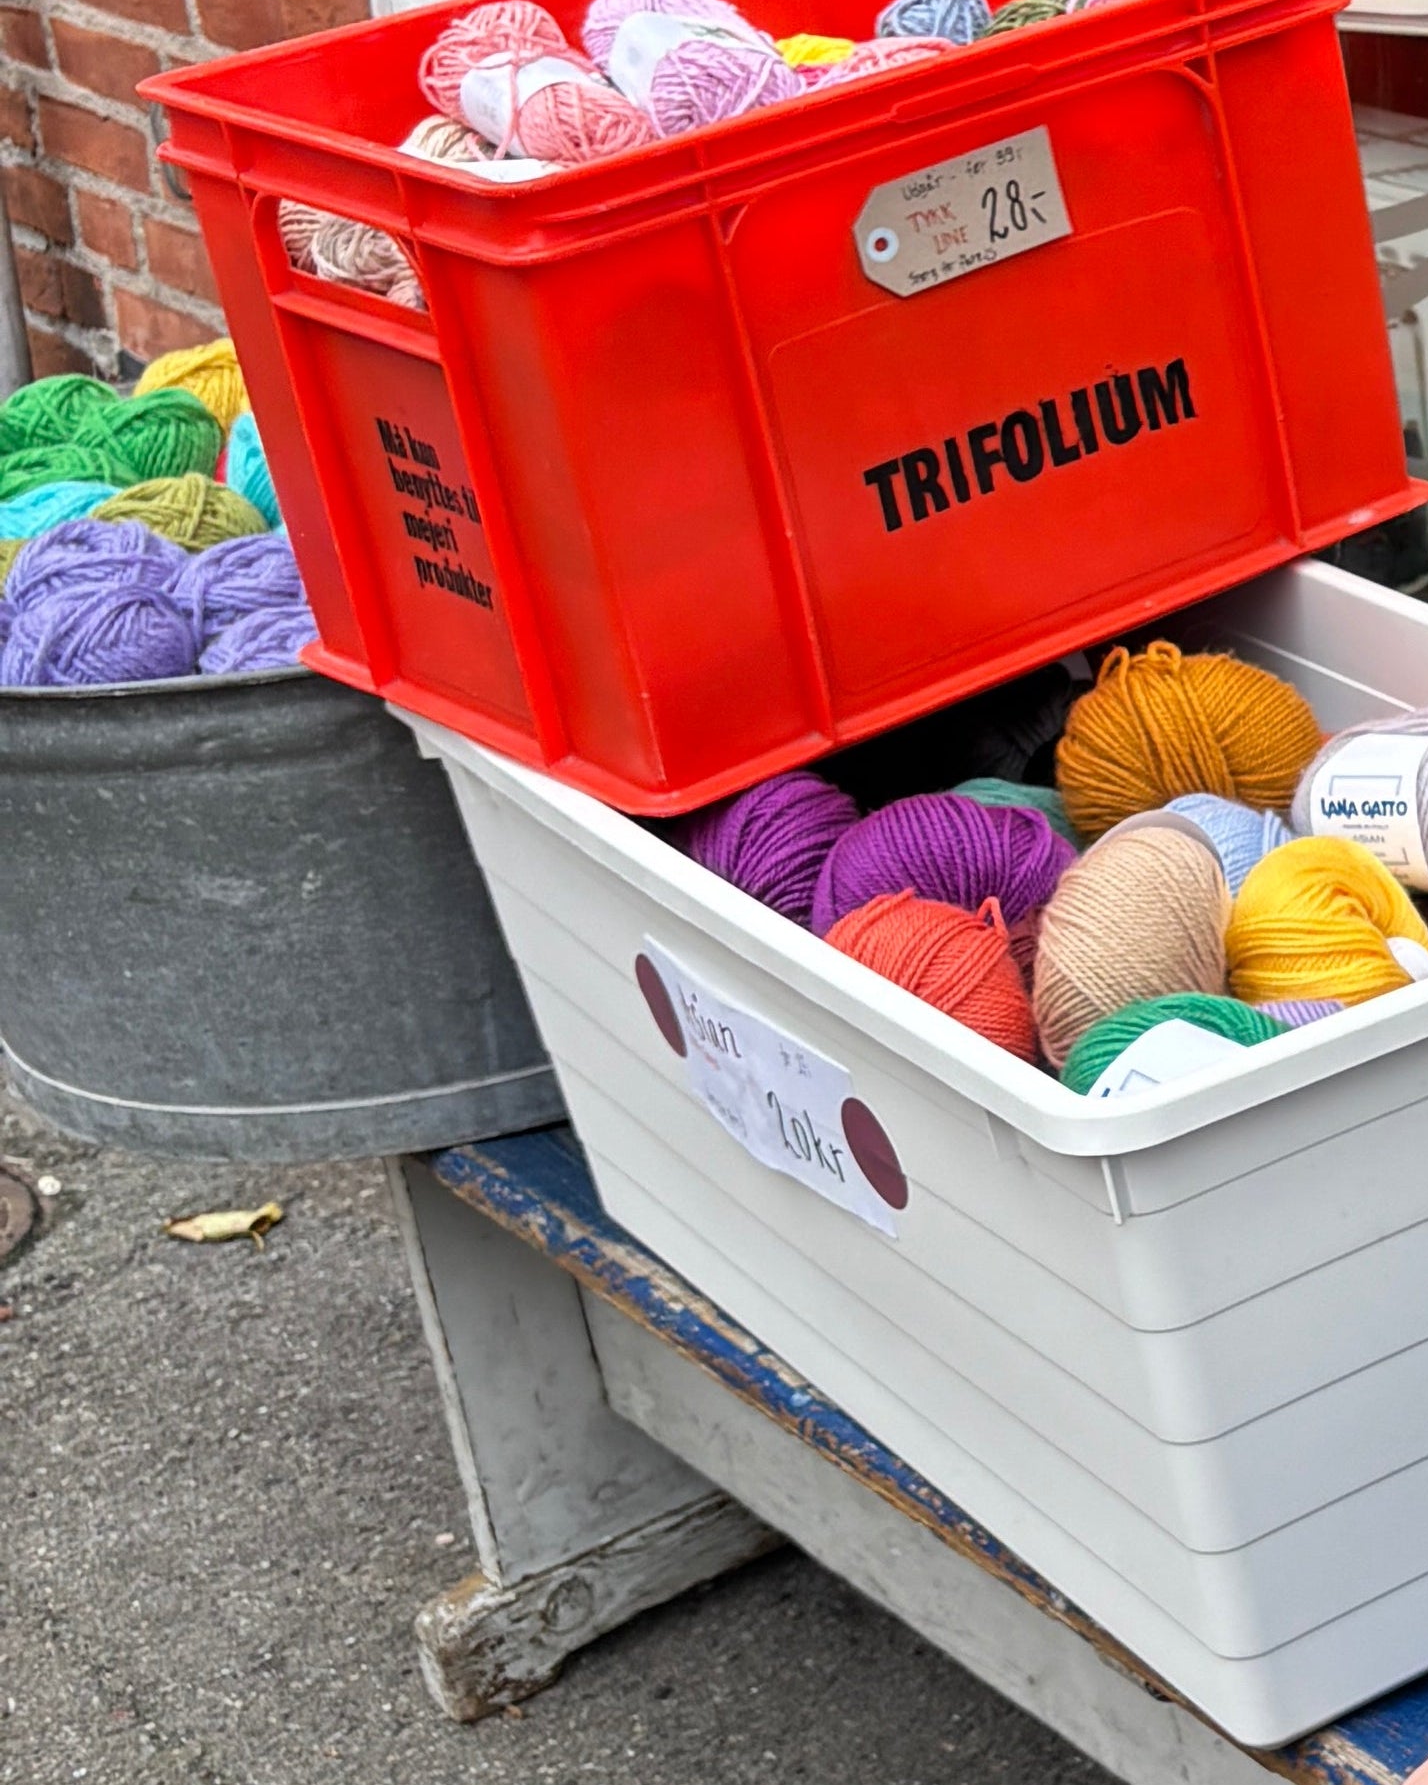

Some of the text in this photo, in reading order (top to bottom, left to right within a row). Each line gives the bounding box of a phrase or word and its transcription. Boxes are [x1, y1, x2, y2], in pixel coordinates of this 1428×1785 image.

[404, 426, 441, 471] kun
[863, 357, 1199, 533] TRIFOLIUM
[388, 457, 464, 515] benyttes
[403, 510, 459, 554] mejeri
[414, 555, 494, 611] produkter
[1320, 797, 1409, 820] LANA GATTO
